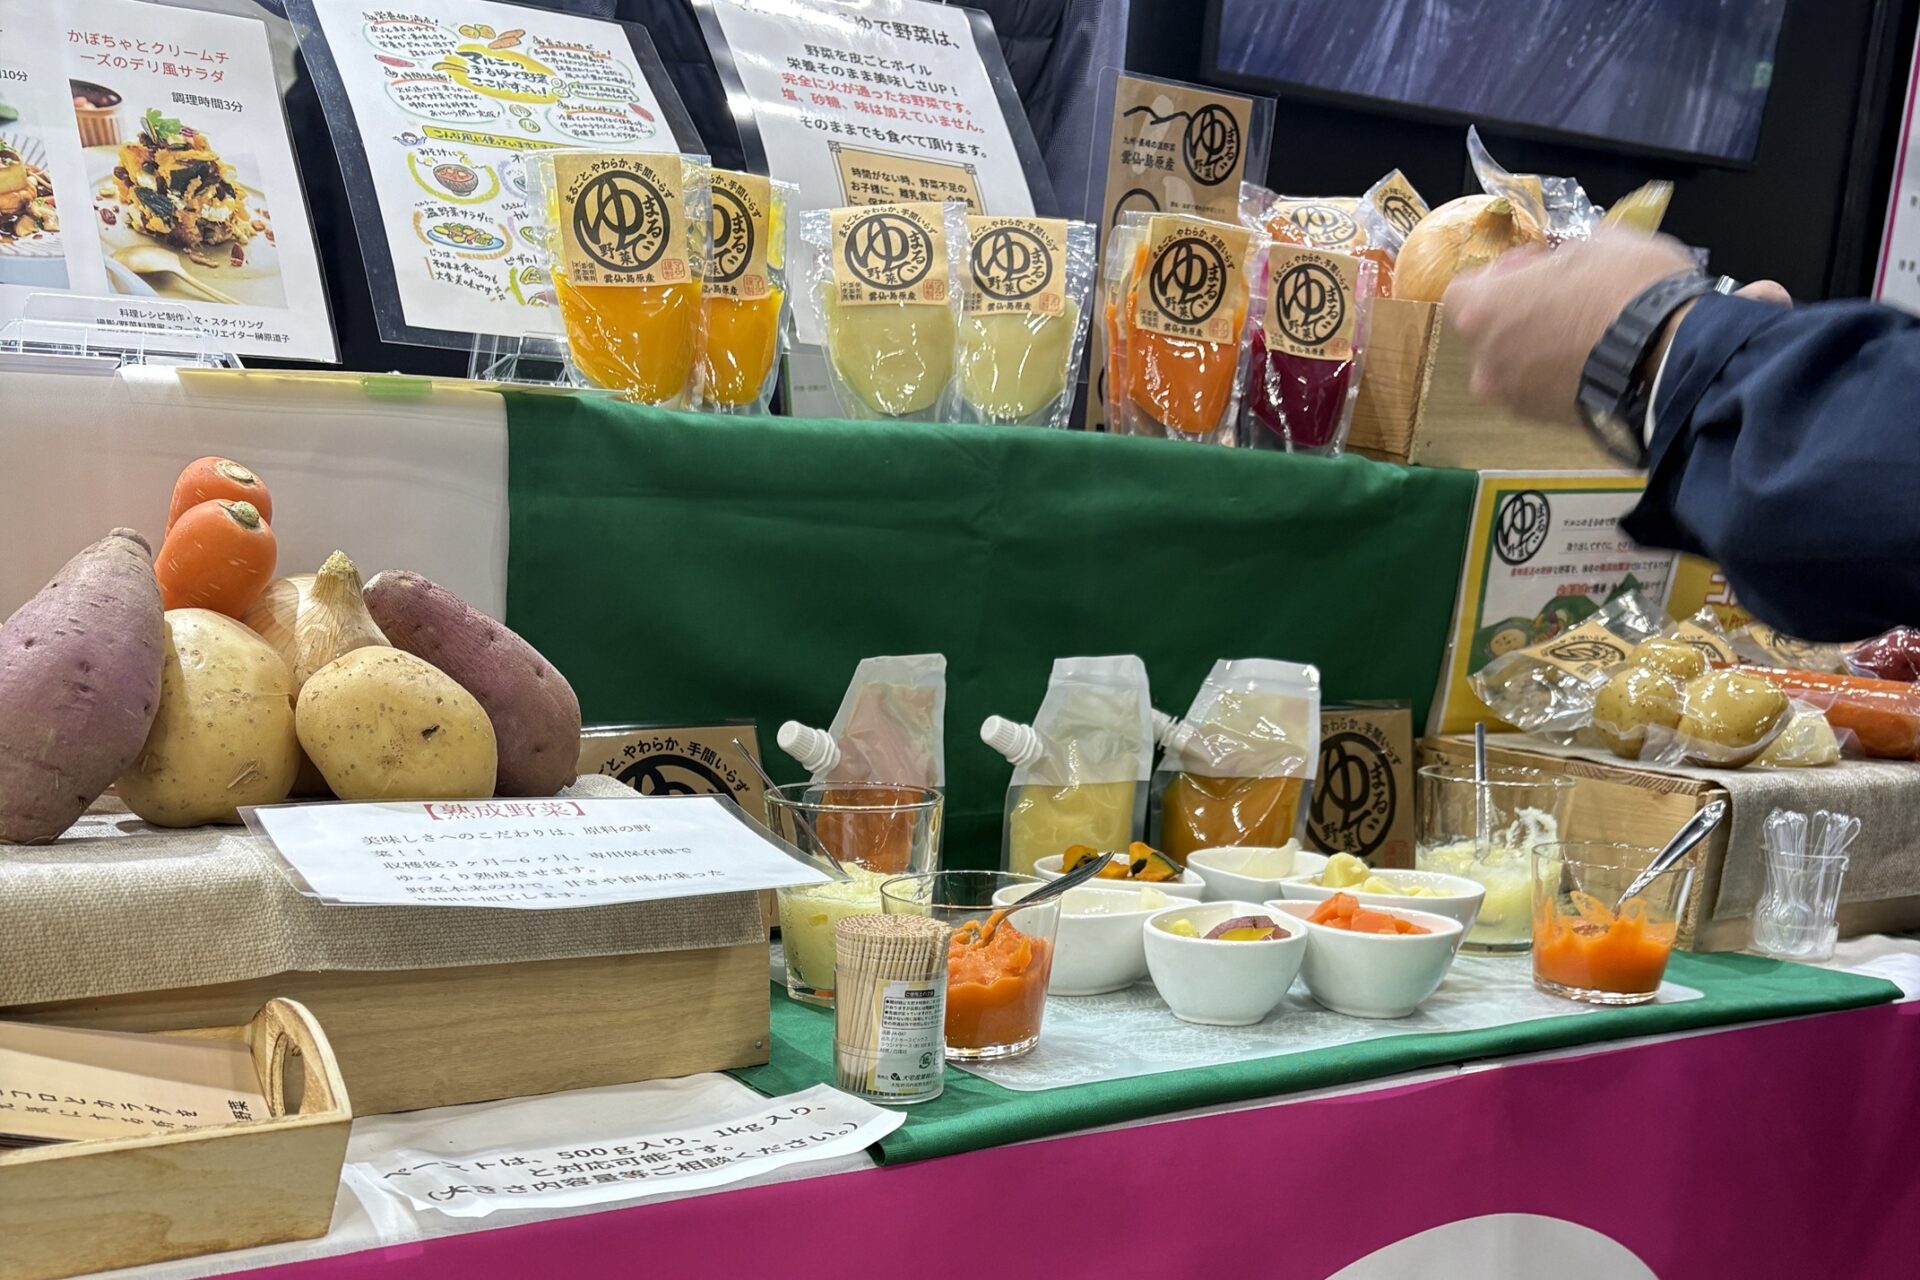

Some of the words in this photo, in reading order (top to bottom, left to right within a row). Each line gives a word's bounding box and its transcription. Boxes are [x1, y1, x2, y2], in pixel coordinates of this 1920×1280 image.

[67, 29, 229, 64] かぼちゃとクリームチ
[804, 43, 932, 77] 野菜を皮ごとボイル
[0, 69, 28, 82] 10分
[80, 53, 225, 84] ーズのデリ風サラダ
[470, 64, 549, 86] まるゆで野菜
[467, 76, 547, 98] ここがすごい!
[781, 72, 972, 116] 完全に火が通ったお野菜です。
[171, 91, 243, 113] 調理時間3分
[781, 87, 985, 134] 塩、砂糖、味は加えていません。
[800, 115, 988, 158] そのままでも食べて頂けます。
[850, 166, 967, 194] 時間がない時、野菜不足の
[603, 273, 656, 284] 雲仙・島原産
[424, 801, 586, 821] 【熟成野菜】
[361, 823, 653, 846] 美味しさへのこだわりは、原料の野
[528, 1143, 734, 1178] と対応可能です。
